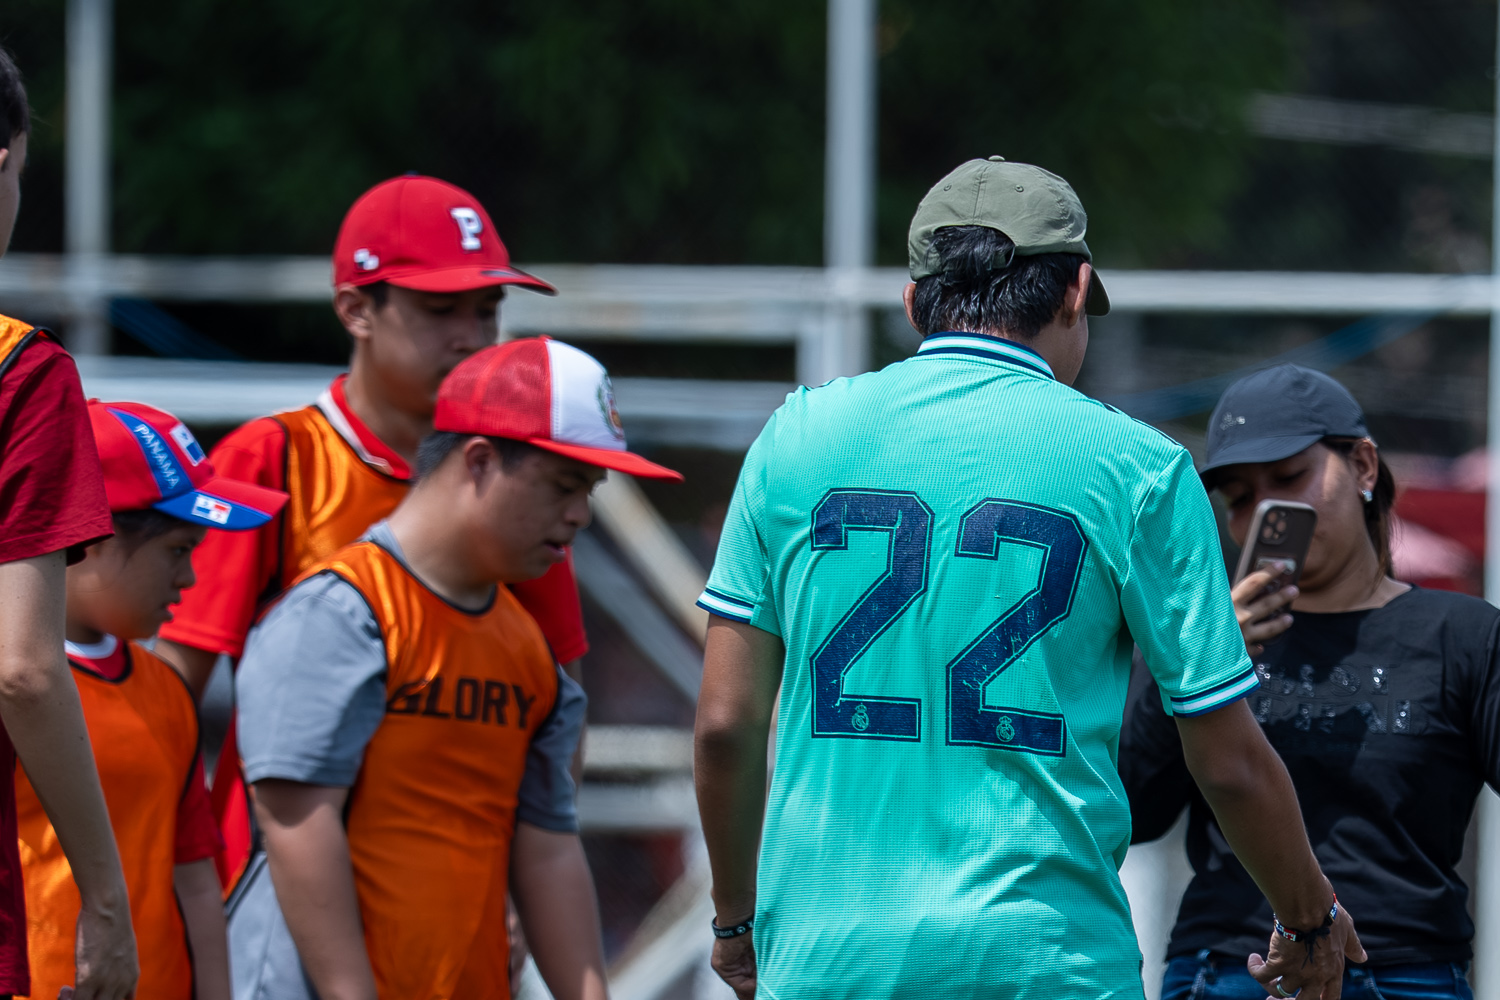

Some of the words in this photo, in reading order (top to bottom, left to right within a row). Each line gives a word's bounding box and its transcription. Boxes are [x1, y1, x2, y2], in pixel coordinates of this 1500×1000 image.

[449, 206, 483, 251] P
[134, 424, 180, 489] PANAMA
[810, 487, 1089, 757] 22
[386, 676, 537, 729] GLORY
